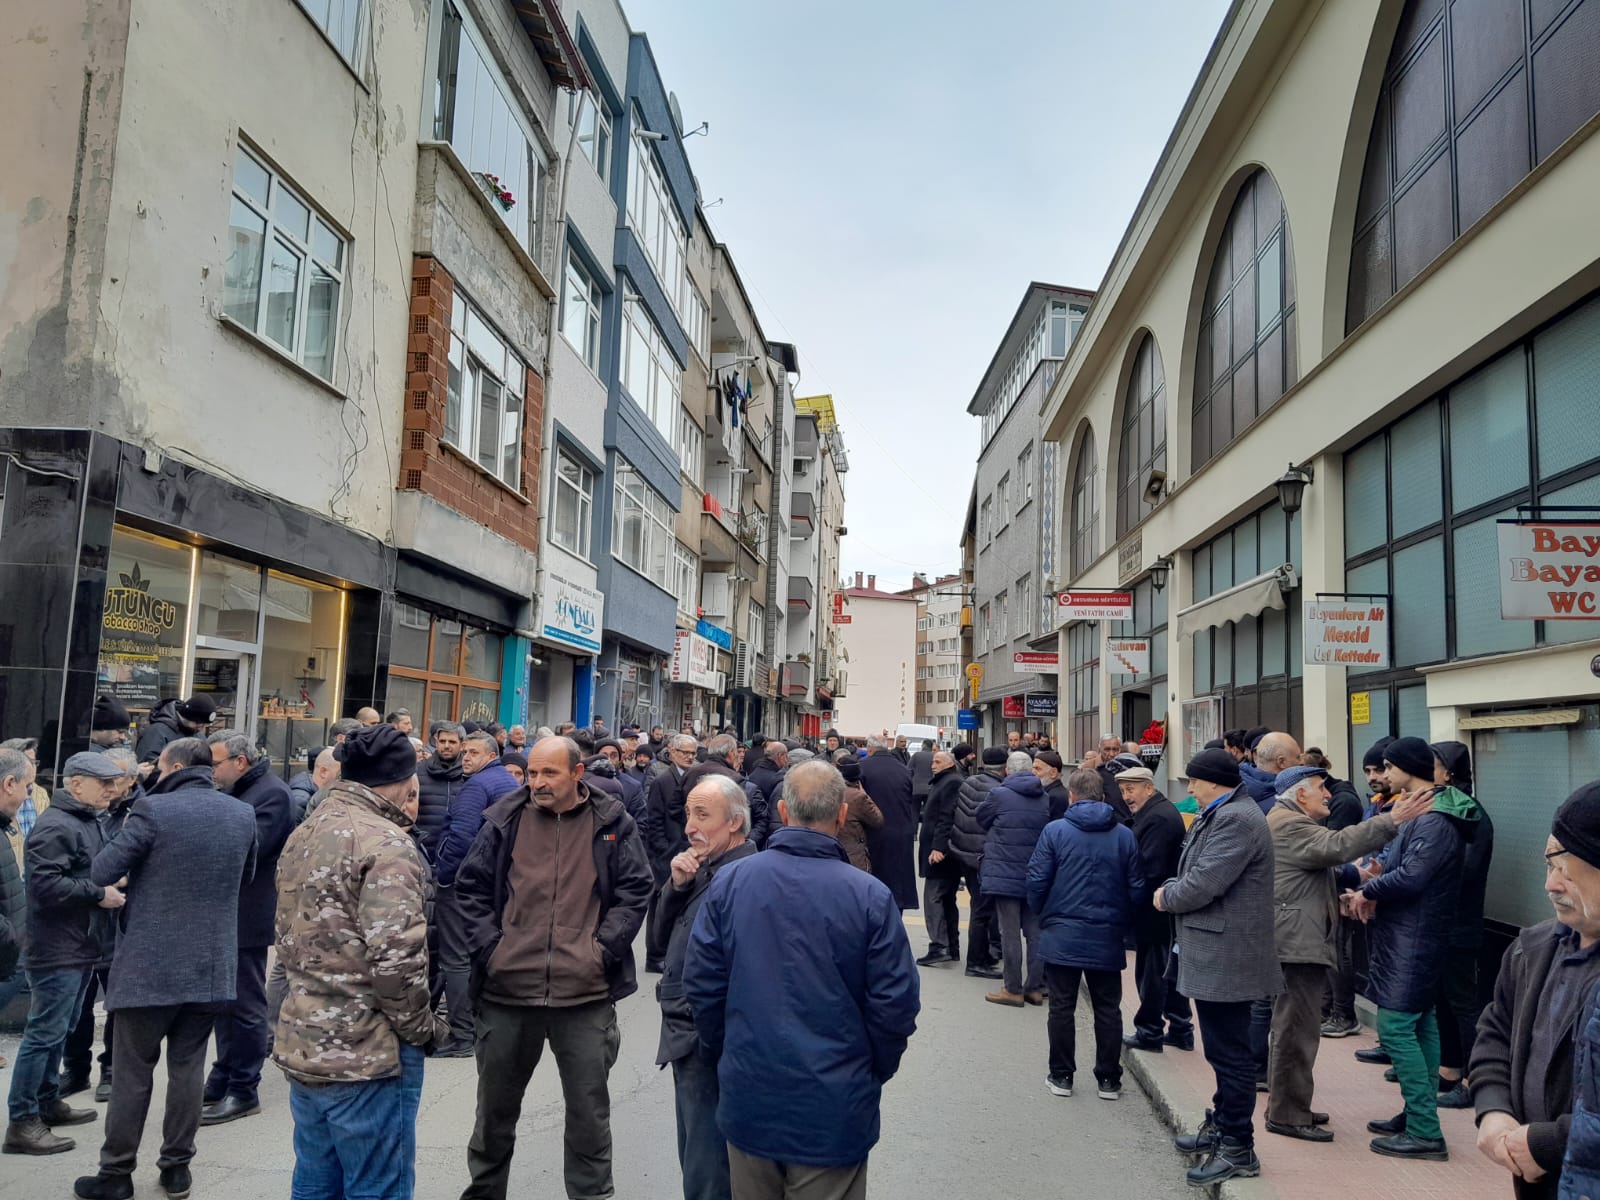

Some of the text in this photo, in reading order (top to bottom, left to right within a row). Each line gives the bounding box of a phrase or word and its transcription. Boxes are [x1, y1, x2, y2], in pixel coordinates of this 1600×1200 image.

[1532, 528, 1600, 557] Bay
[1547, 591, 1597, 614] WC
[1368, 607, 1385, 621] Ait
[104, 615, 160, 637] obacco shop
[1323, 625, 1370, 643] Mescid
[1335, 648, 1381, 663] Kattadır
